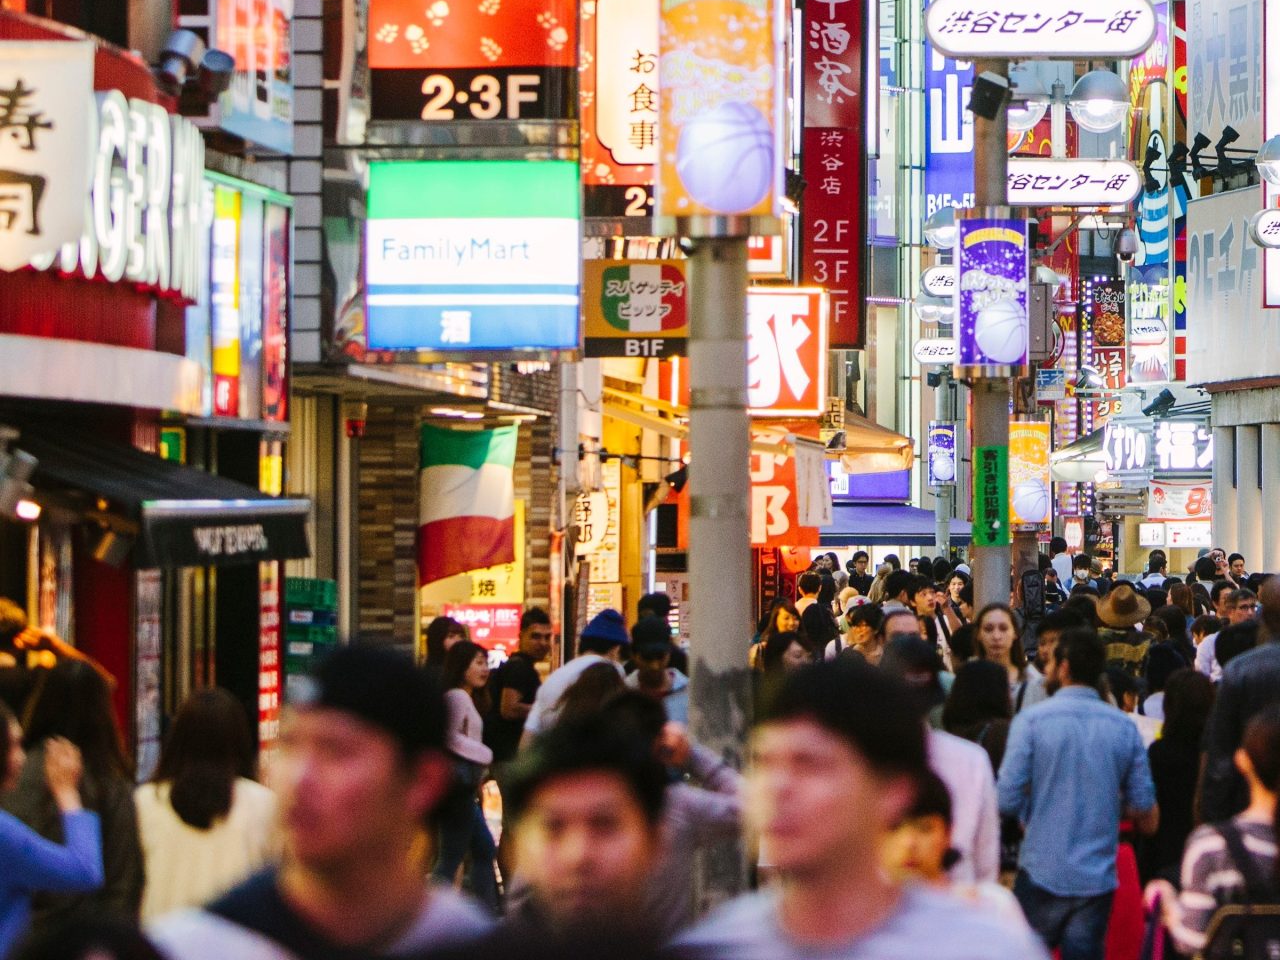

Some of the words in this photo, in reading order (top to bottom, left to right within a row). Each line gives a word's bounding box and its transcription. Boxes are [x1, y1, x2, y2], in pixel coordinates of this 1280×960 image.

[939, 9, 1143, 35] 渋谷センター街
[628, 48, 658, 150] お食事
[0, 78, 53, 235] 寿司
[820, 131, 844, 195] 渋谷店
[813, 220, 849, 242] 2F
[381, 237, 530, 265] FamilyMart
[814, 260, 849, 282] 3F
[606, 281, 685, 296] スパゲッティ
[618, 302, 671, 317] ピッツァ
[440, 310, 471, 344] 酒
[625, 340, 664, 356] B1F
